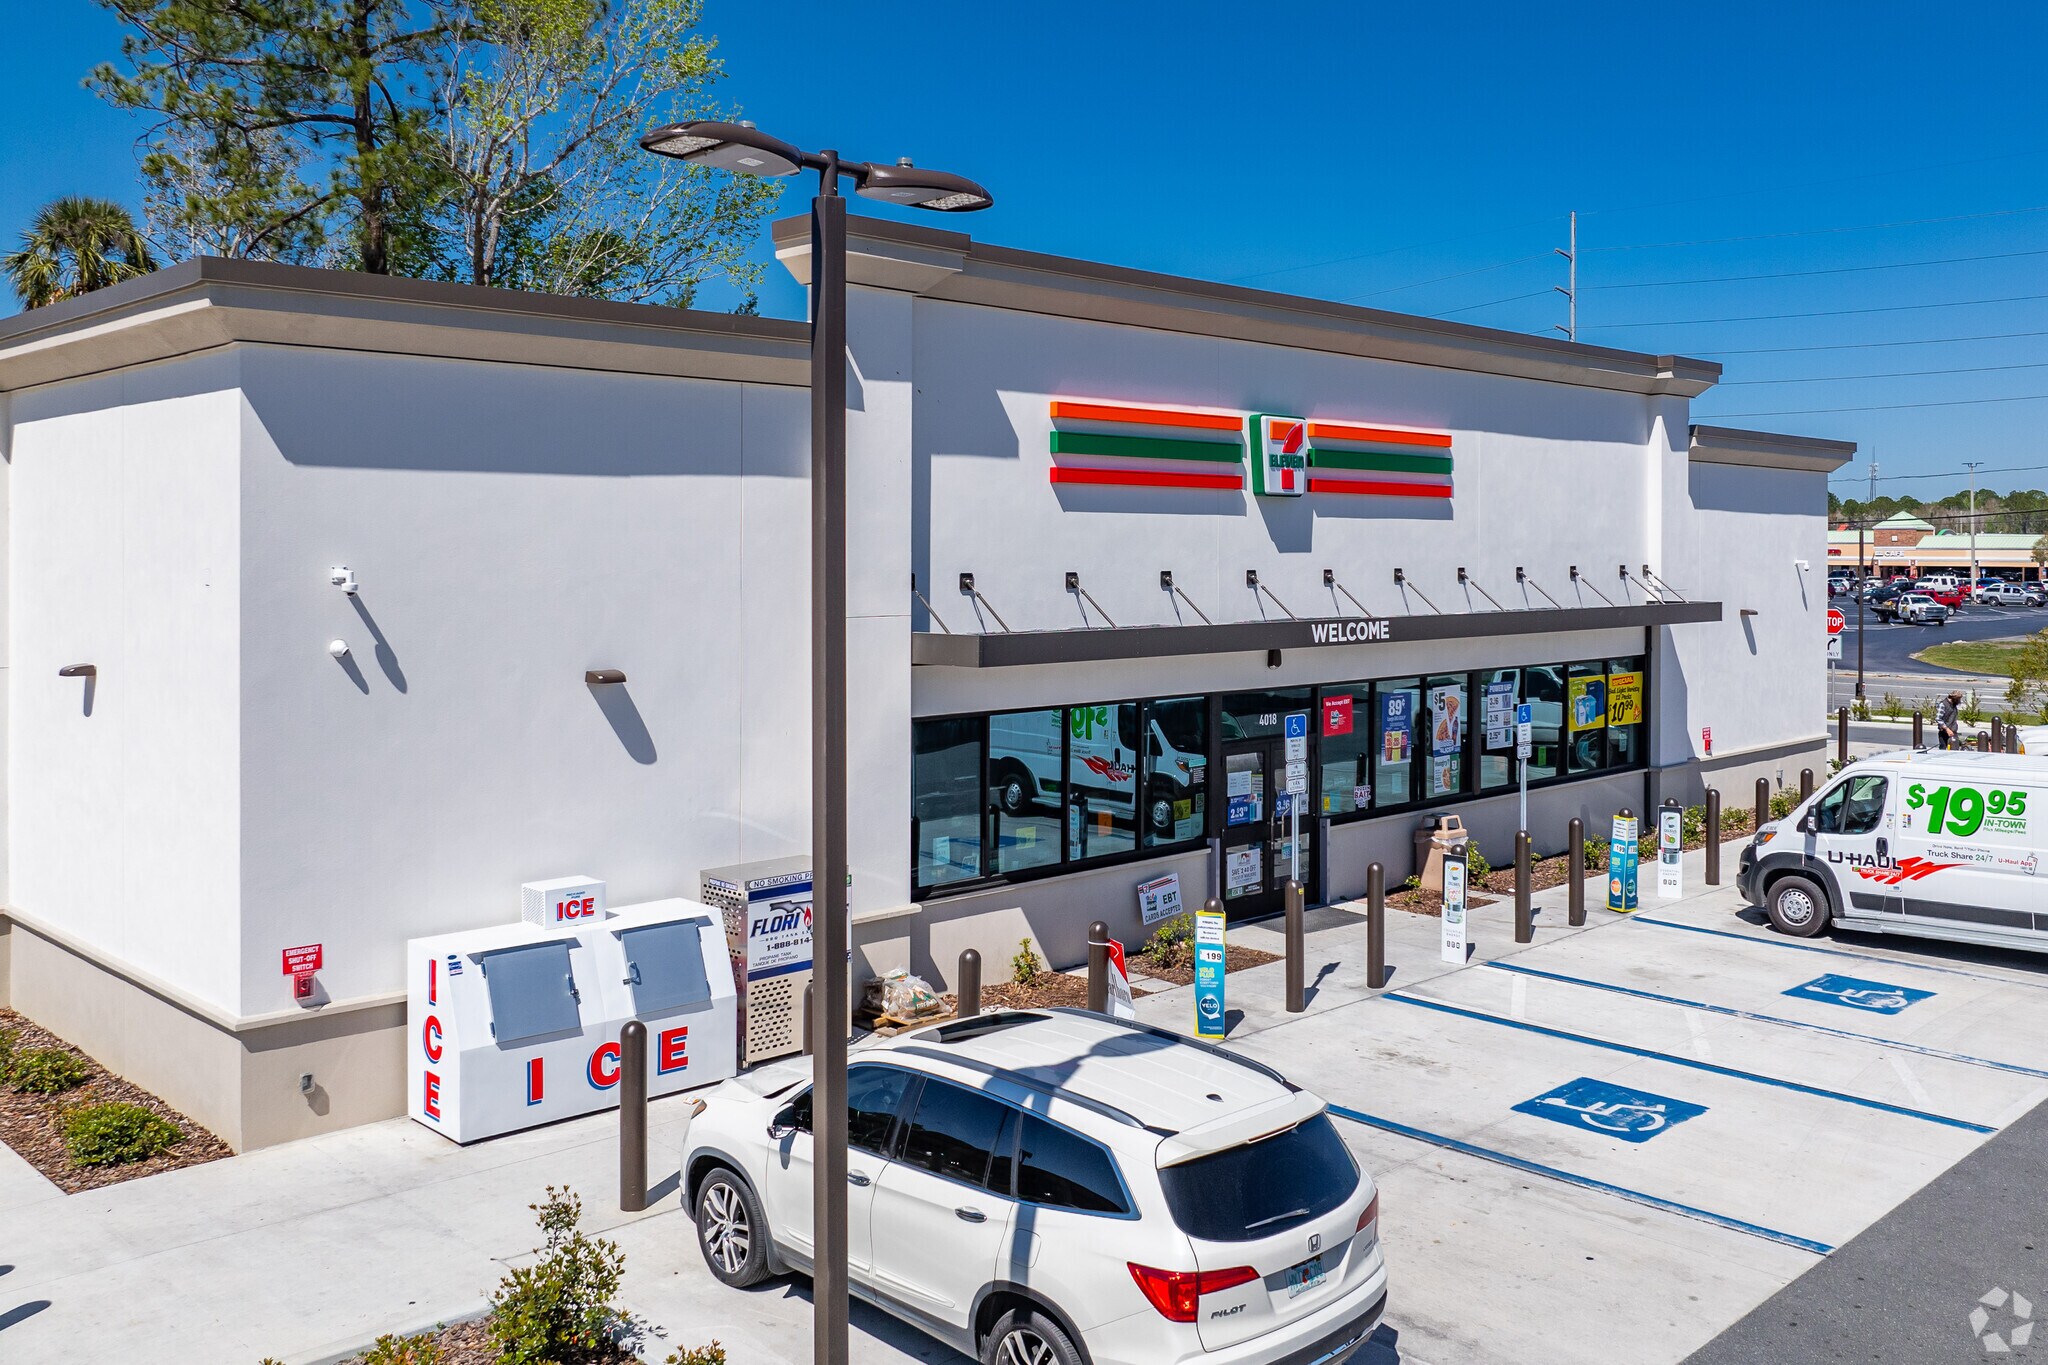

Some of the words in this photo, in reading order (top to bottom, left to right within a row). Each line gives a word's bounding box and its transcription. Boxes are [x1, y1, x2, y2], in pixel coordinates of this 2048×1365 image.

[1827, 617, 1843, 627] TOP
[1311, 621, 1390, 644] WELCOME
[1612, 676, 1634, 686] SPECIAL
[1434, 692, 1446, 711] $5
[1259, 713, 1277, 726] 4018
[1354, 791, 1370, 799] BAIT
[1984, 819, 2027, 829] IN-TOWN
[1828, 850, 1902, 871] U-HAUL
[1927, 850, 1949, 858] Truck
[1951, 852, 1974, 860] Share
[1975, 854, 1994, 863] 24/7
[754, 880, 765, 888] NO
[768, 874, 803, 884] SMOKING
[1162, 891, 1177, 905] EBT
[557, 898, 595, 921] ICE
[1145, 911, 1160, 922] CARDS
[1160, 904, 1181, 917] ACCEPTED
[285, 945, 320, 957] EMERGENCY
[766, 936, 813, 952] 1-888-814-
[288, 954, 318, 965] SHUT-OFF
[292, 962, 314, 972] SWITCH
[423, 959, 443, 1123] ICE
[1211, 1303, 1247, 1320] PILOT
